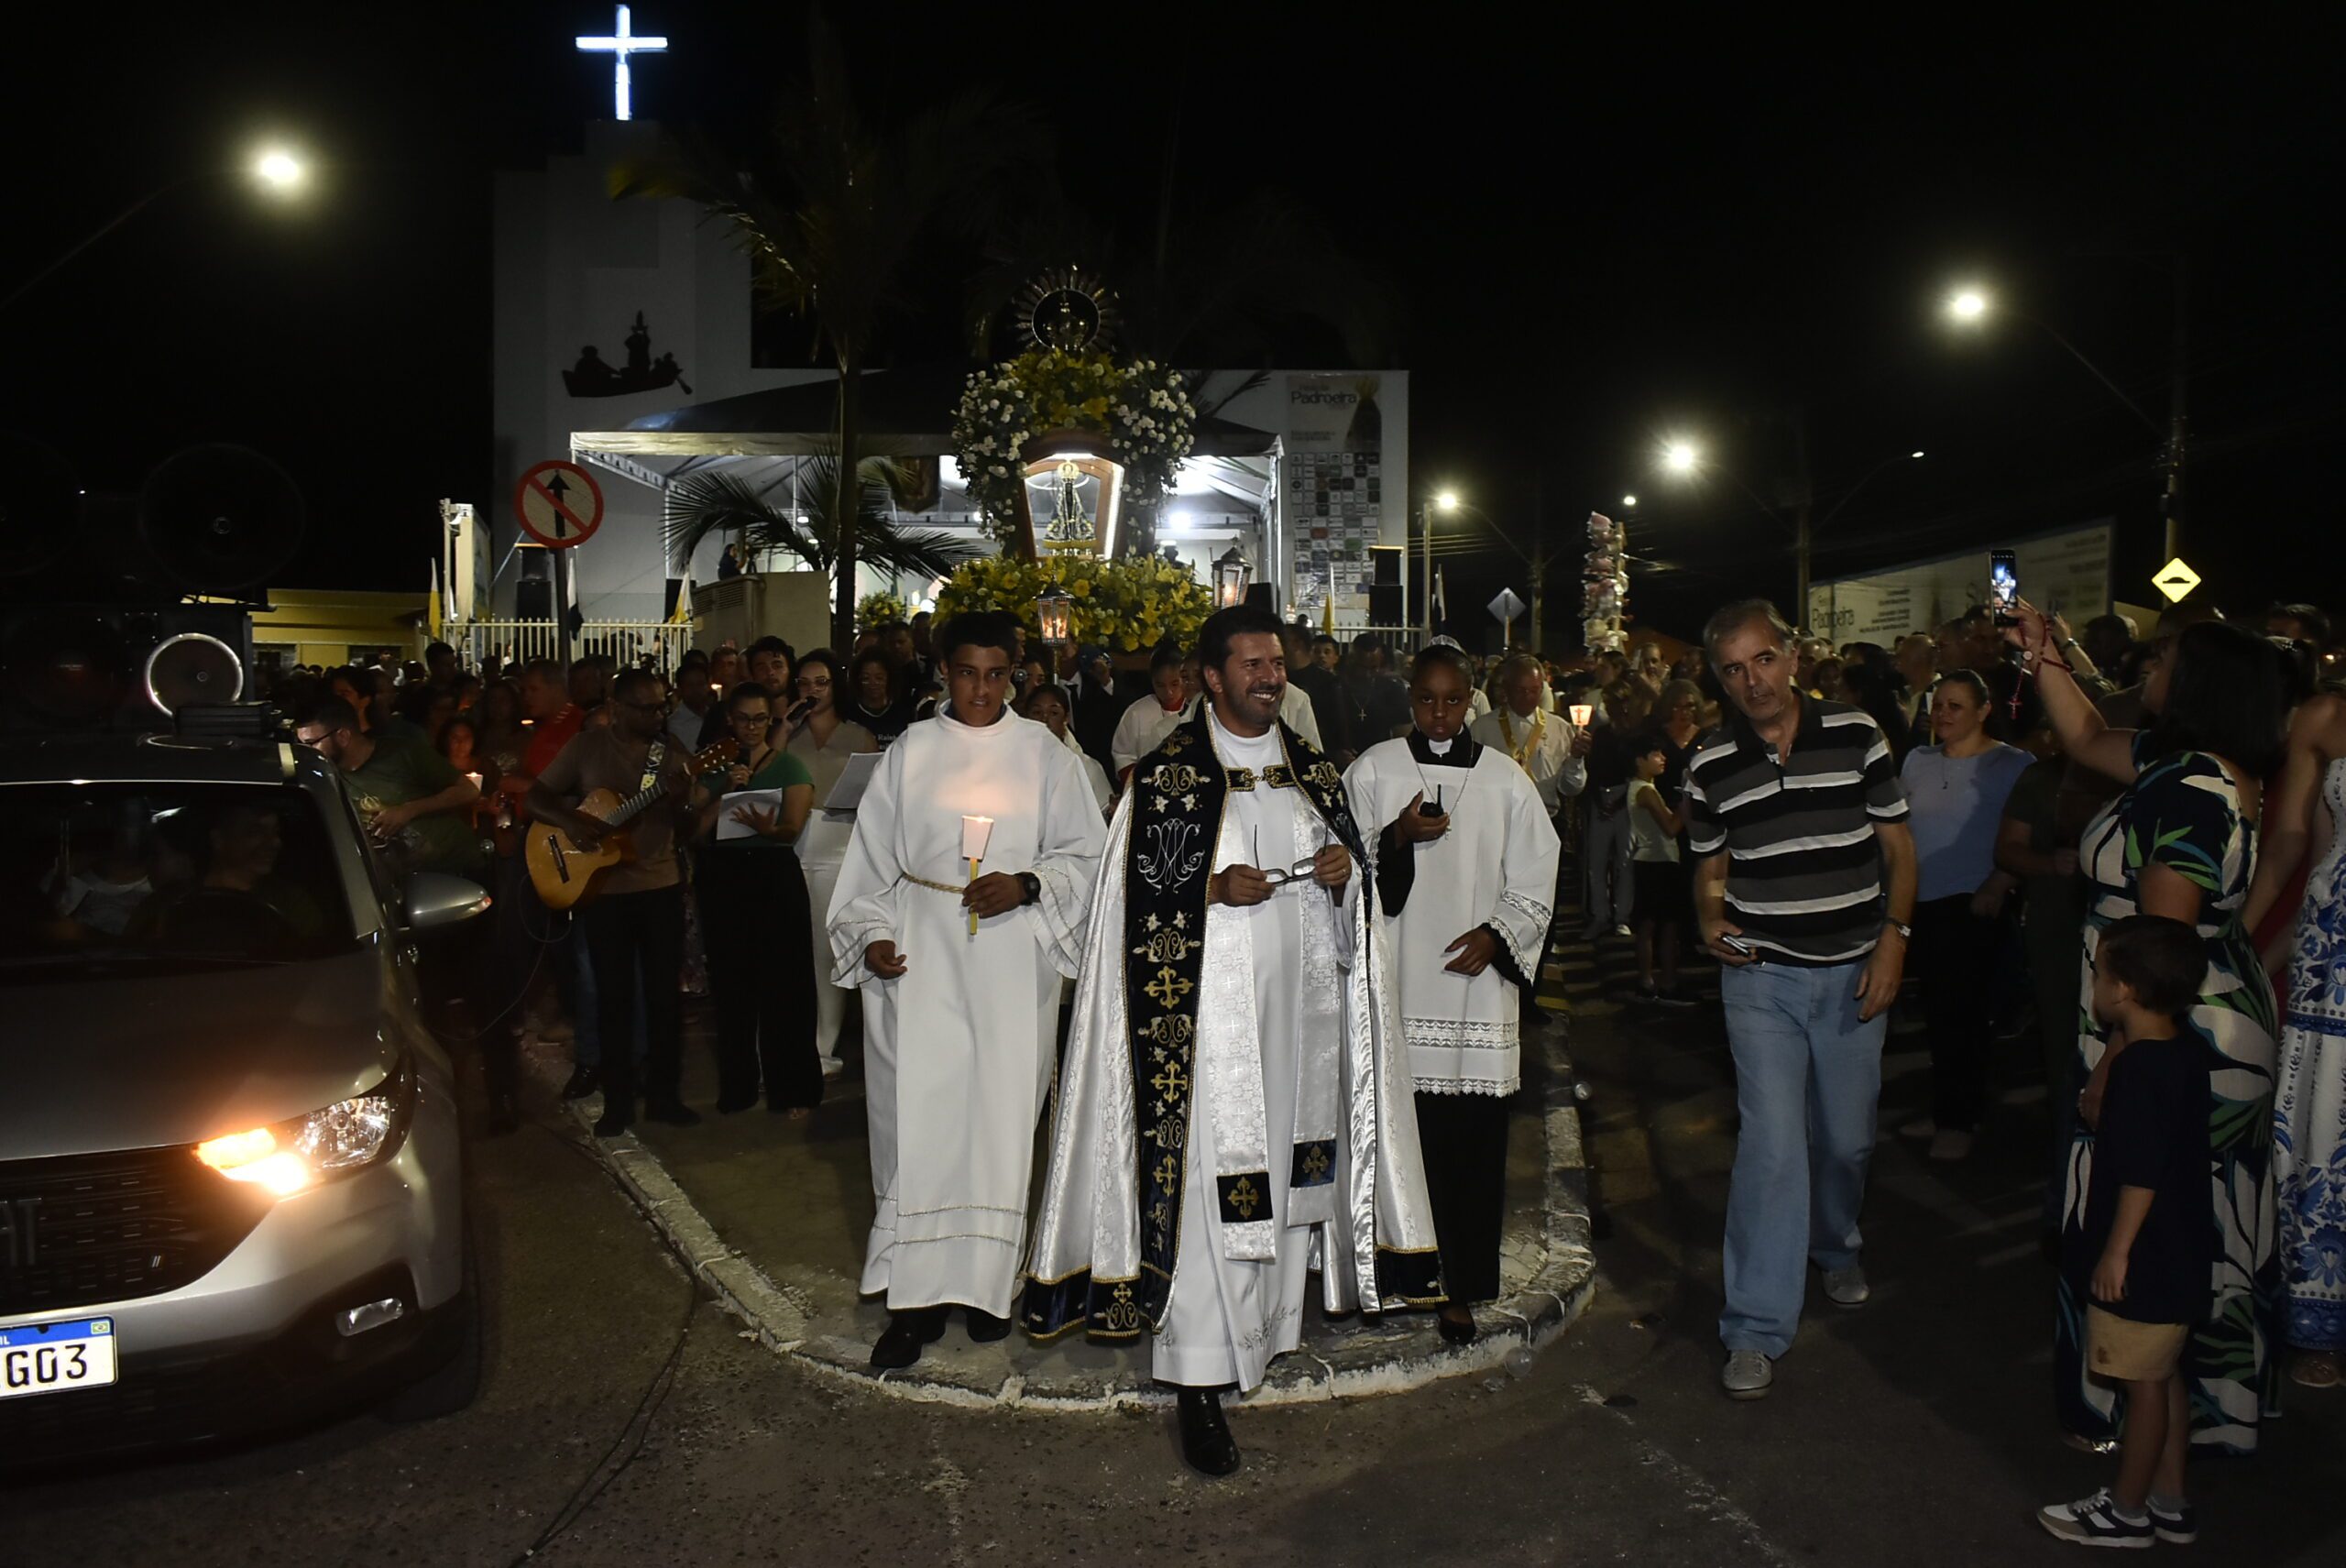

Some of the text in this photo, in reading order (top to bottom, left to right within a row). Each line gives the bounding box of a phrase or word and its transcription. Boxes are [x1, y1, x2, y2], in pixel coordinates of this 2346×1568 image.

[1290, 390, 1357, 403] Padroeira
[1811, 606, 1855, 630] Padoeira
[5, 1343, 88, 1388] G03
